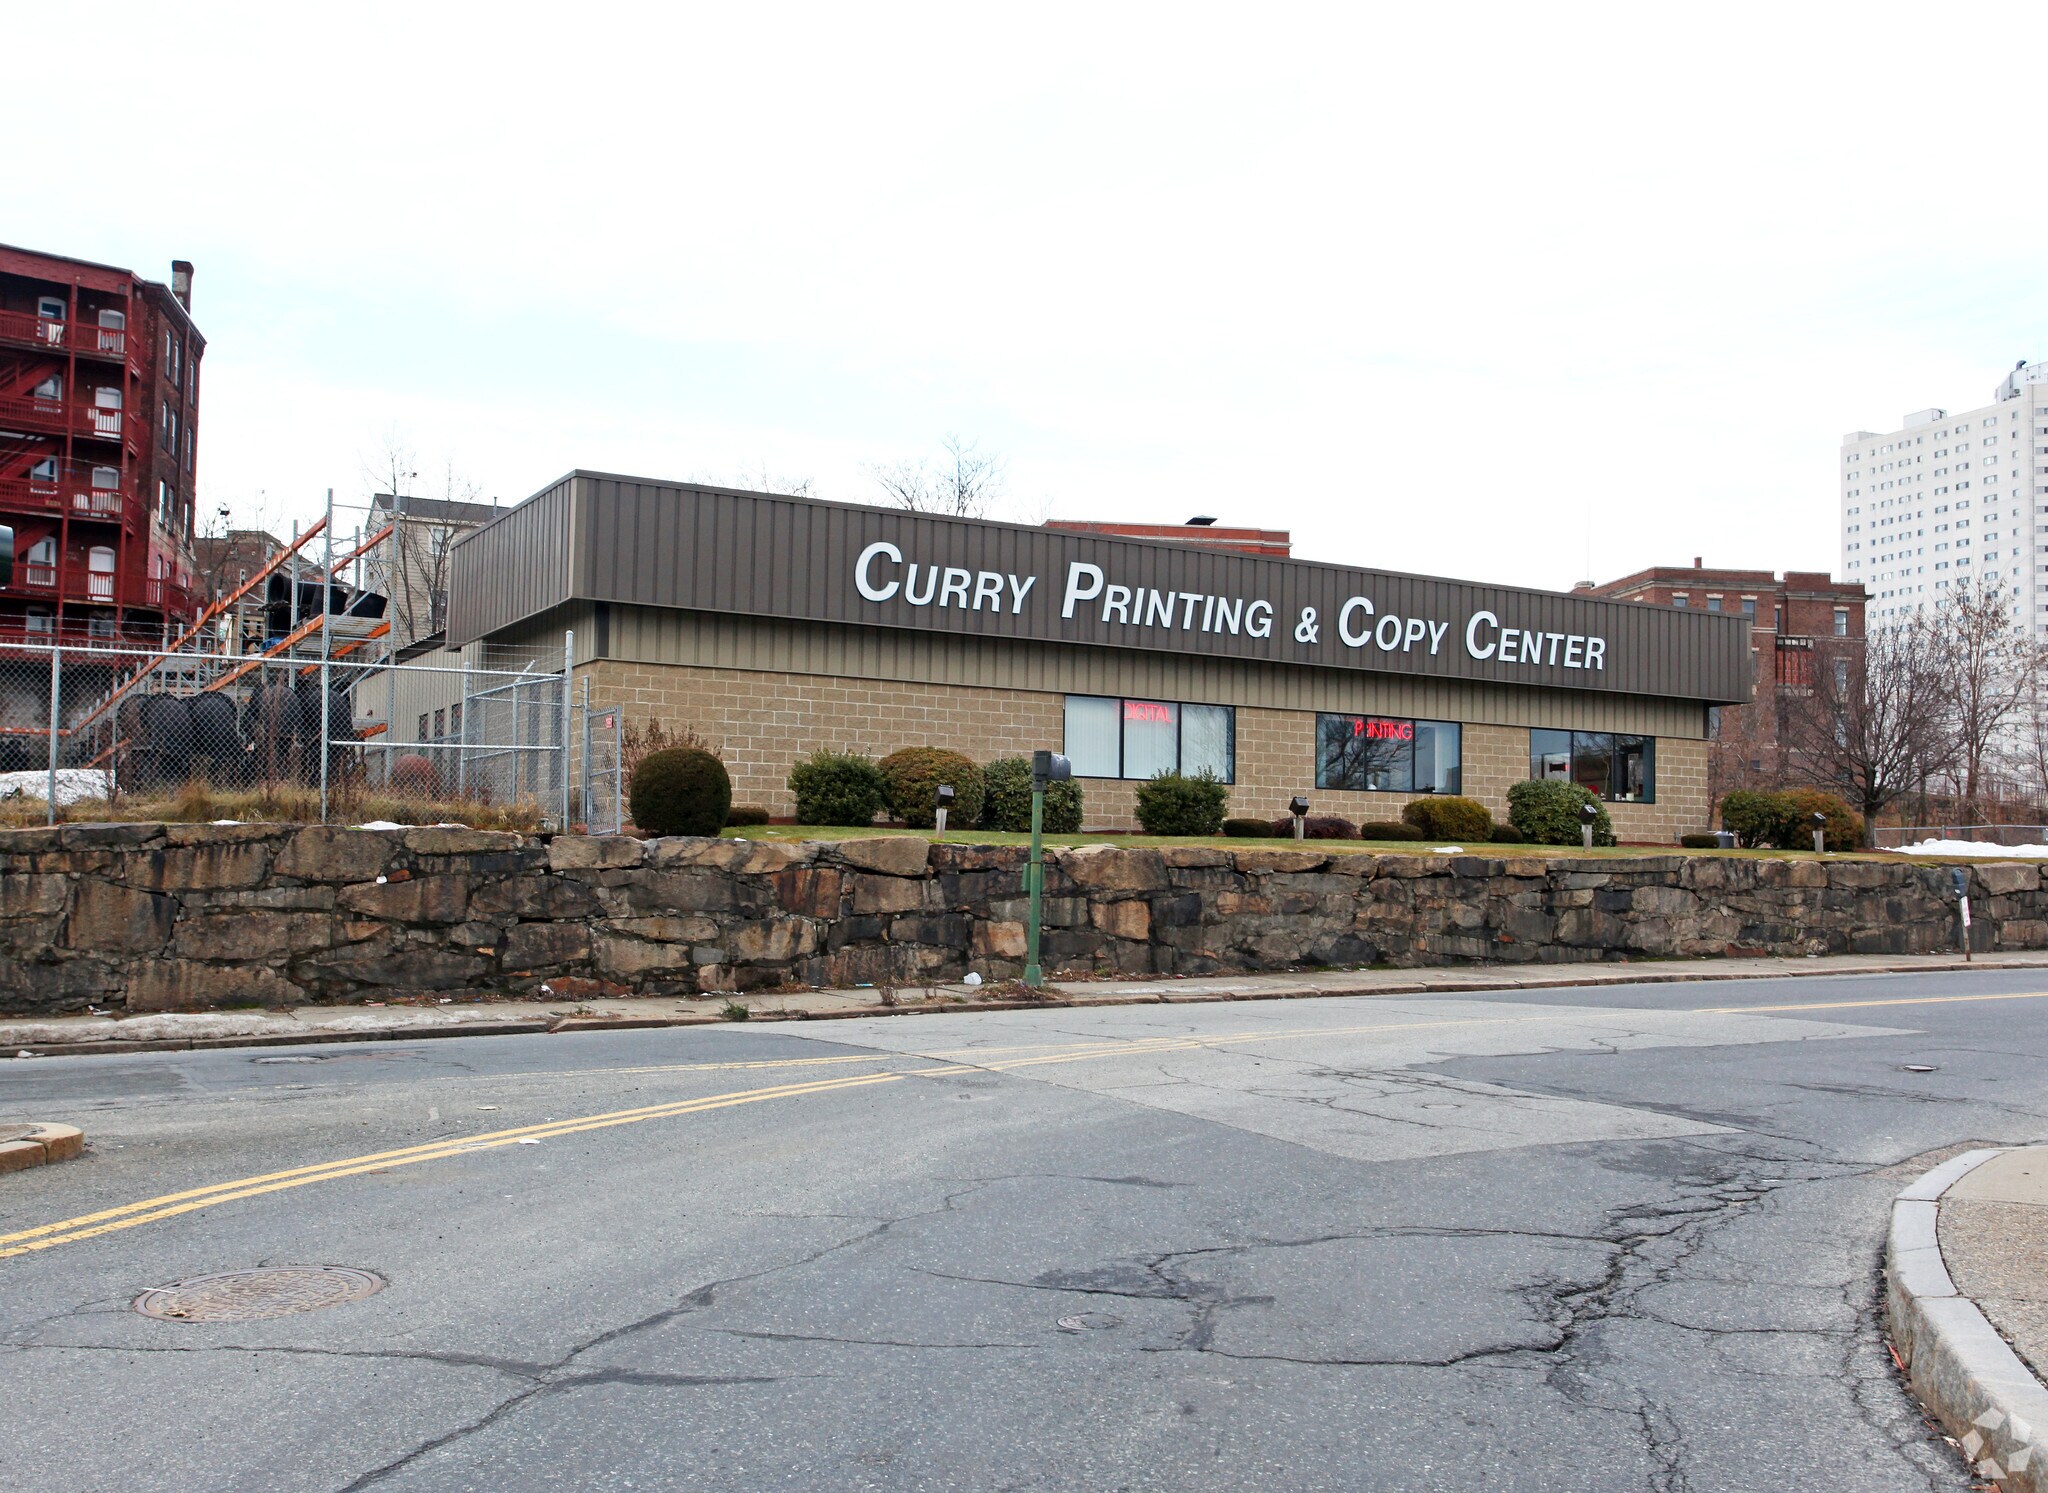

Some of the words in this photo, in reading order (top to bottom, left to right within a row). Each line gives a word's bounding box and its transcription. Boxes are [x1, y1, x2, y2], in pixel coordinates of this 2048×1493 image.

[854, 541, 1036, 614] CURRY
[1061, 561, 1274, 638] PRINTING
[1294, 606, 1319, 644] &
[1338, 596, 1449, 655] COPY
[1465, 610, 1606, 670] CENTER
[1123, 702, 1172, 723] DIGITAL
